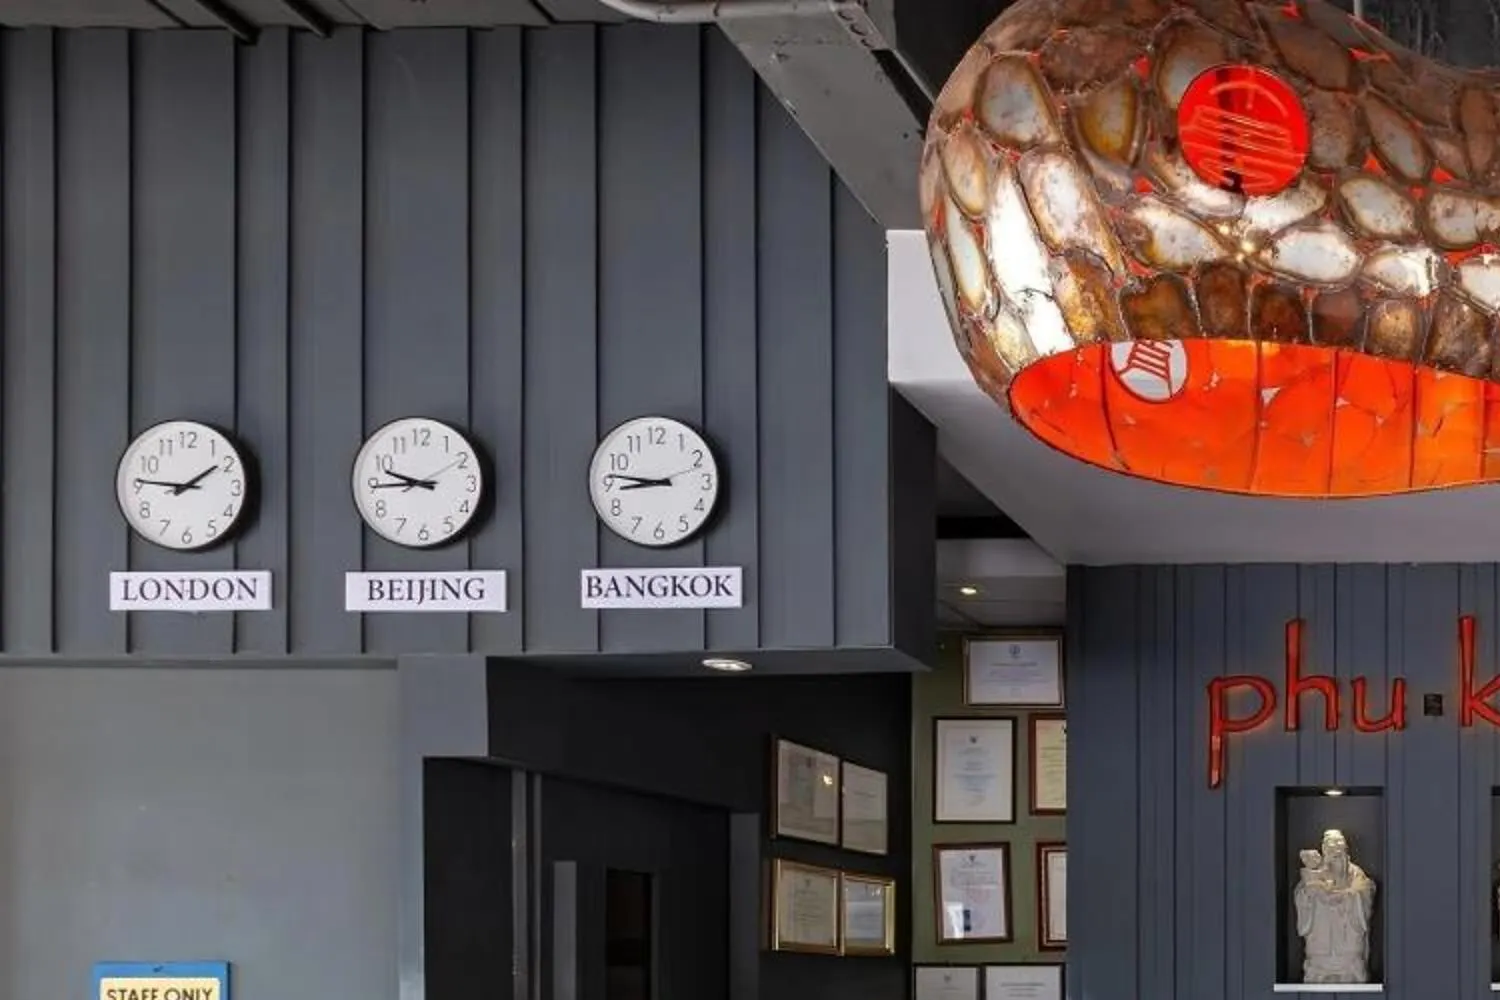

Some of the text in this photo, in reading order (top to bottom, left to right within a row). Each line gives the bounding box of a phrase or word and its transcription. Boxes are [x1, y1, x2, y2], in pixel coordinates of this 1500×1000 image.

[179, 431, 198, 449] 12
[392, 436, 406, 454] 11
[412, 428, 431, 447] 12
[443, 435, 449, 453] 1
[627, 435, 641, 453] 11
[647, 427, 666, 445] 12
[678, 433, 685, 451] 1
[159, 439, 173, 456] 11
[210, 439, 216, 457] 1
[141, 455, 159, 474] 10
[223, 456, 235, 473] 2
[375, 454, 393, 473] 10
[456, 452, 469, 469] 2
[609, 453, 629, 471] 10
[692, 450, 703, 468] 2
[133, 478, 143, 494] 9
[231, 479, 242, 497] 3
[368, 477, 379, 494] 9
[466, 475, 477, 493] 3
[603, 475, 615, 492] 9
[701, 473, 712, 491] 3
[139, 502, 150, 519] 8
[223, 503, 233, 519] 4
[375, 500, 387, 518] 8
[459, 499, 470, 513] 4
[611, 498, 622, 516] 8
[694, 498, 705, 512] 4
[159, 519, 171, 536] 7
[206, 519, 217, 538] 5
[395, 516, 407, 534] 7
[418, 524, 430, 541] 6
[443, 516, 455, 534] 5
[631, 516, 642, 534] 7
[653, 521, 664, 539] 6
[678, 516, 689, 533] 5
[181, 526, 193, 544] 6
[121, 577, 257, 602] LONDON
[367, 577, 485, 605] BEIJING
[586, 575, 733, 599] BANGKOK
